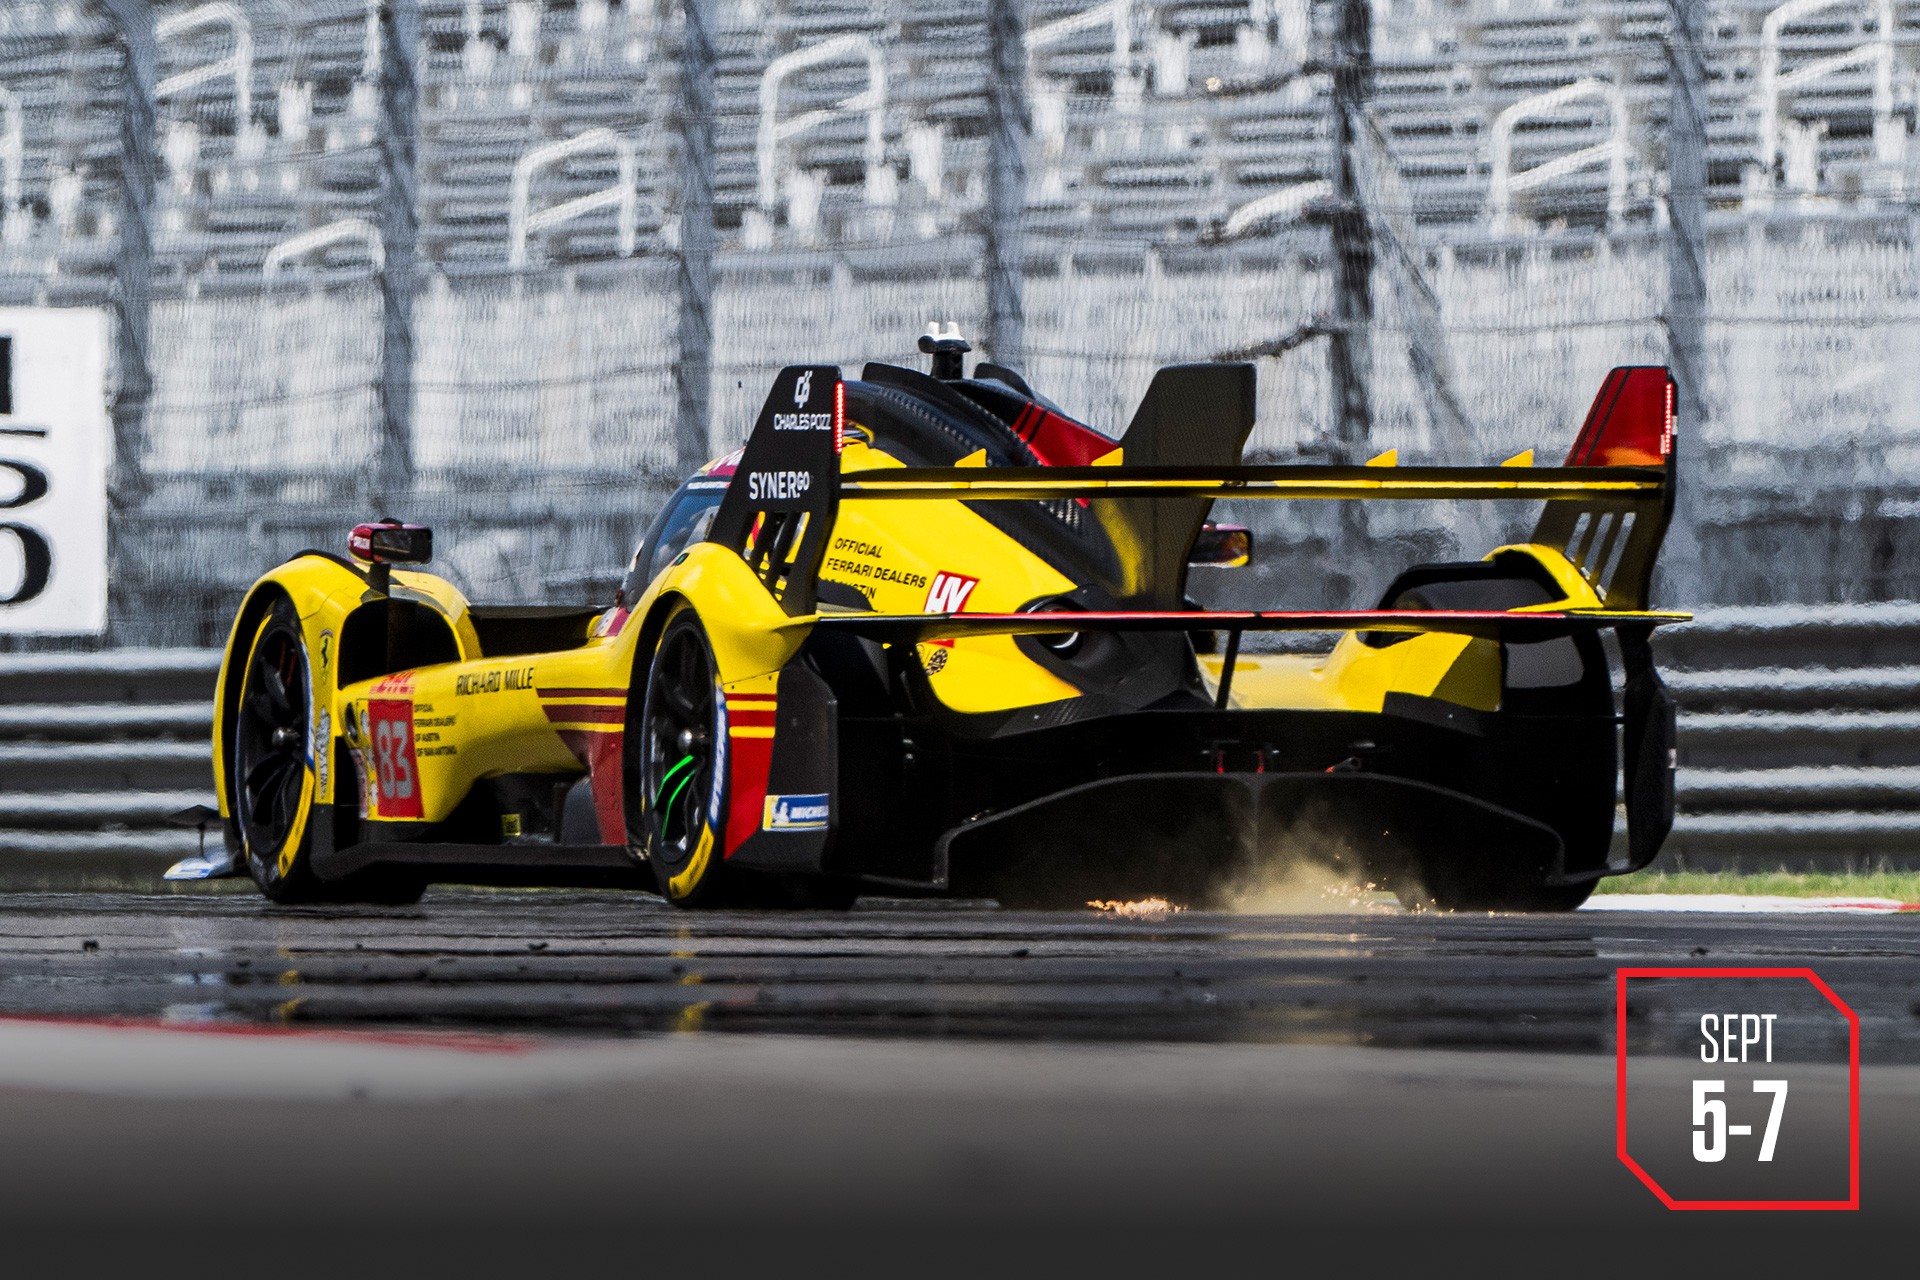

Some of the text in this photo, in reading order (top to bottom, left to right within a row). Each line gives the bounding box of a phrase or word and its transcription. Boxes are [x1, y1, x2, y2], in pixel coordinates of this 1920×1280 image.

[774, 413, 832, 430] CHARLES POZZ
[834, 537, 883, 559] OFFICIAL
[826, 557, 928, 589] FERRARI DEALERS
[456, 667, 535, 696] RICHARD MILLE
[376, 719, 413, 799] 83
